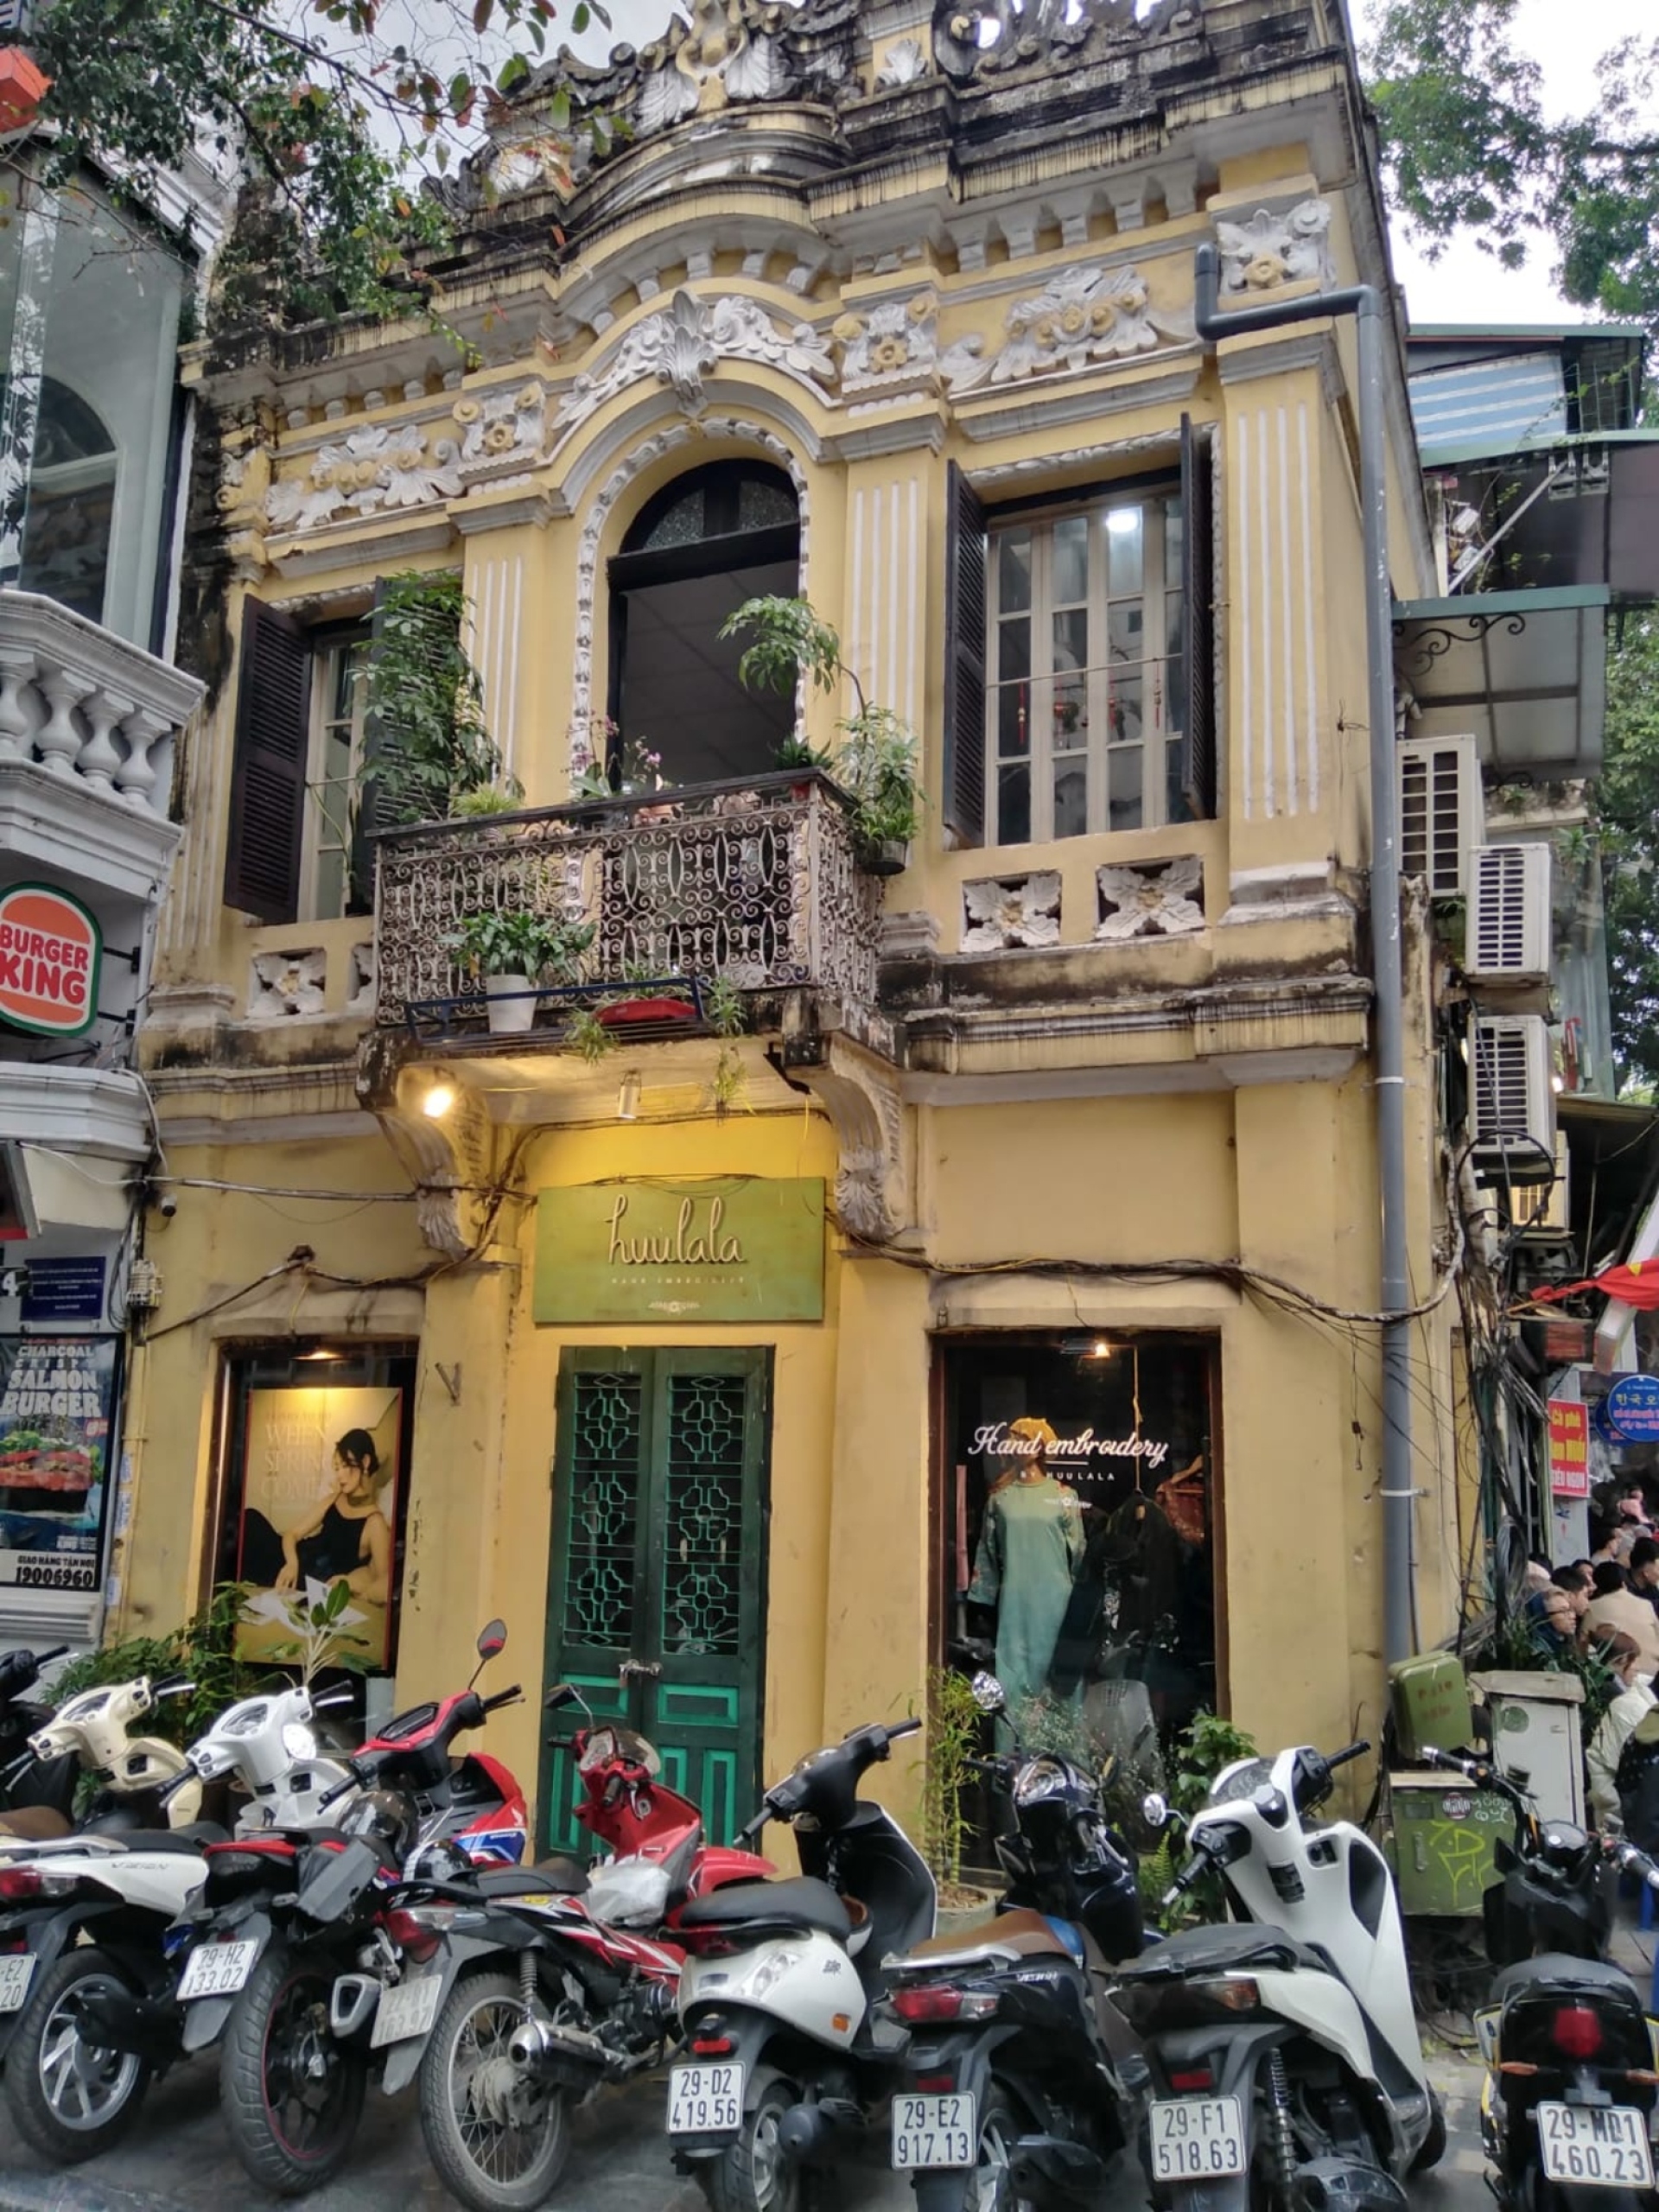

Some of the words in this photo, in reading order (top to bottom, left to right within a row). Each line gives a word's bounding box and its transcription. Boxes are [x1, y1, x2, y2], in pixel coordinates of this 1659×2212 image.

[0, 925, 88, 971] BURGER
[0, 950, 86, 1005] KING
[604, 1194, 744, 1263] huulala
[17, 1344, 94, 1357] CHARCOAL
[8, 1370, 99, 1390] SALMON
[0, 1391, 102, 1417] BURGER
[968, 1421, 1043, 1455] Hand
[1046, 1427, 1169, 1468] embroidery
[1046, 1471, 1116, 1482] HUULALA
[17, 1555, 36, 1564] GIAO
[16, 1566, 93, 1587] 19006960
[185, 1967, 245, 1995] 133.02
[680, 2068, 732, 2098] 29-D2
[671, 2099, 737, 2129] 419.56
[904, 2098, 961, 2129] 29-E2
[1163, 2102, 1225, 2138] 29-F1
[898, 2132, 969, 2164] 917.13
[1159, 2138, 1238, 2174] 518.63
[1552, 2144, 1646, 2182] 460.23
